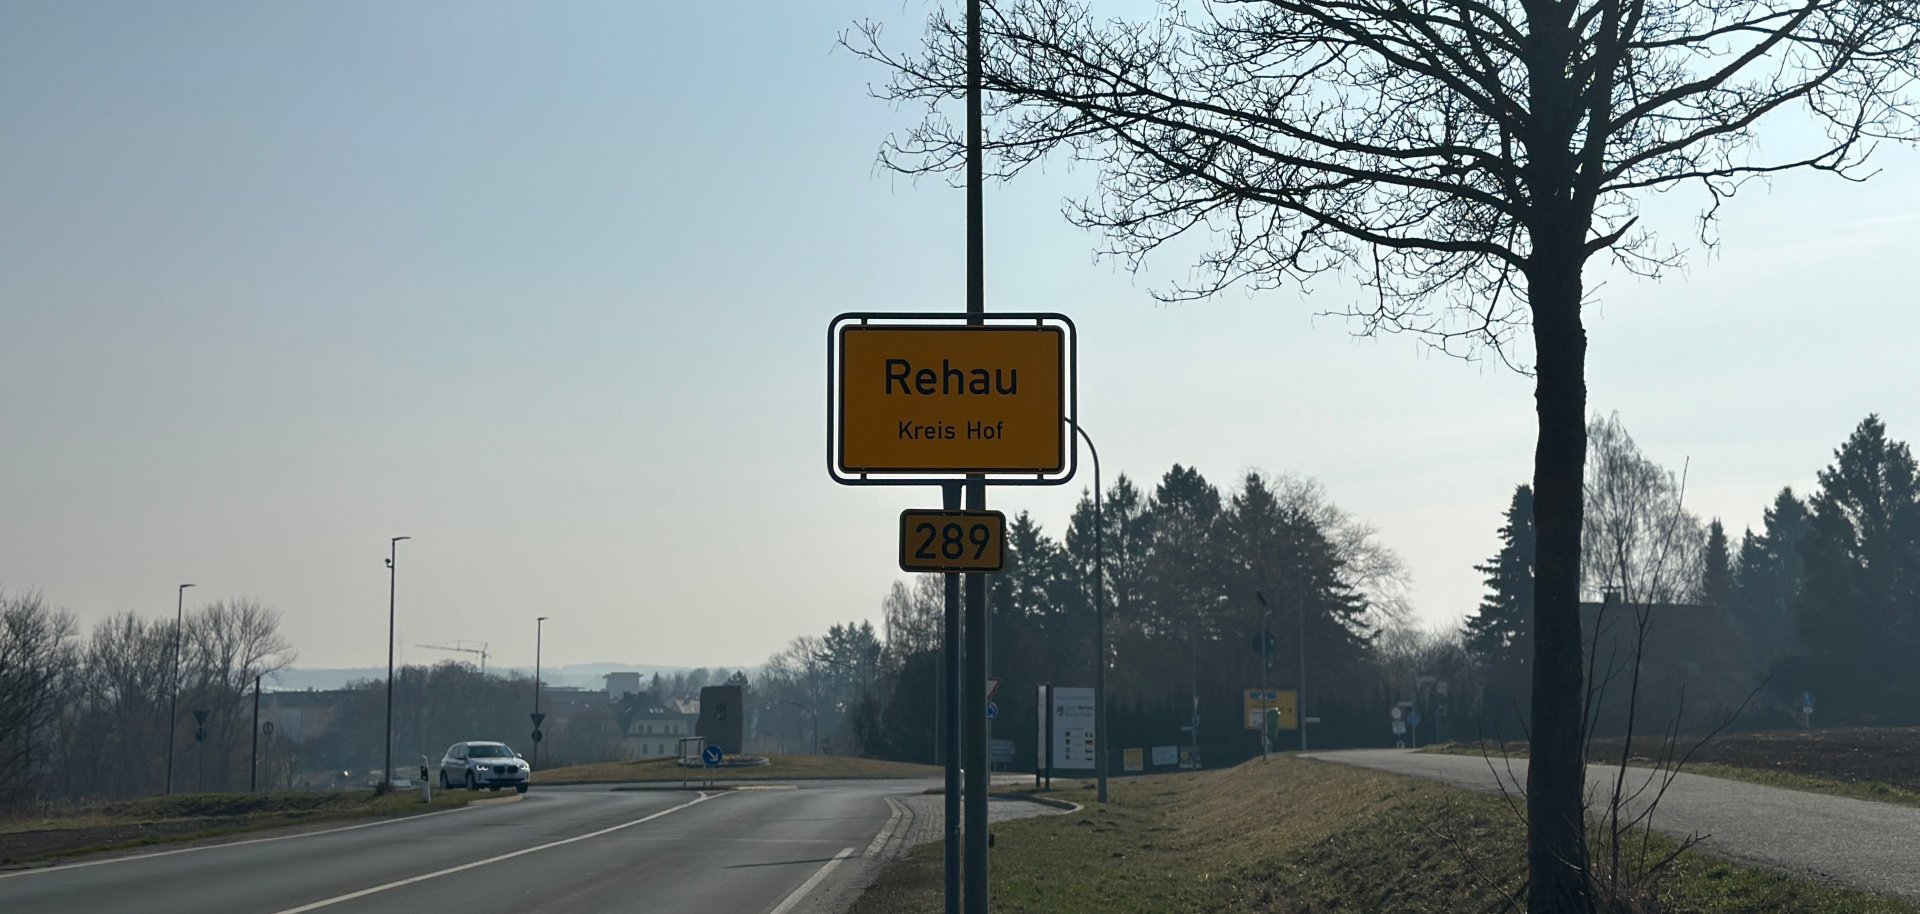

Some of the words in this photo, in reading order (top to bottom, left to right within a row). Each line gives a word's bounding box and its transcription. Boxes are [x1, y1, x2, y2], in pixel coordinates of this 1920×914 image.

[885, 359, 1017, 395] Rehau
[898, 421, 956, 440] Kreis
[967, 421, 1004, 440] Hof
[914, 522, 990, 560] 289
